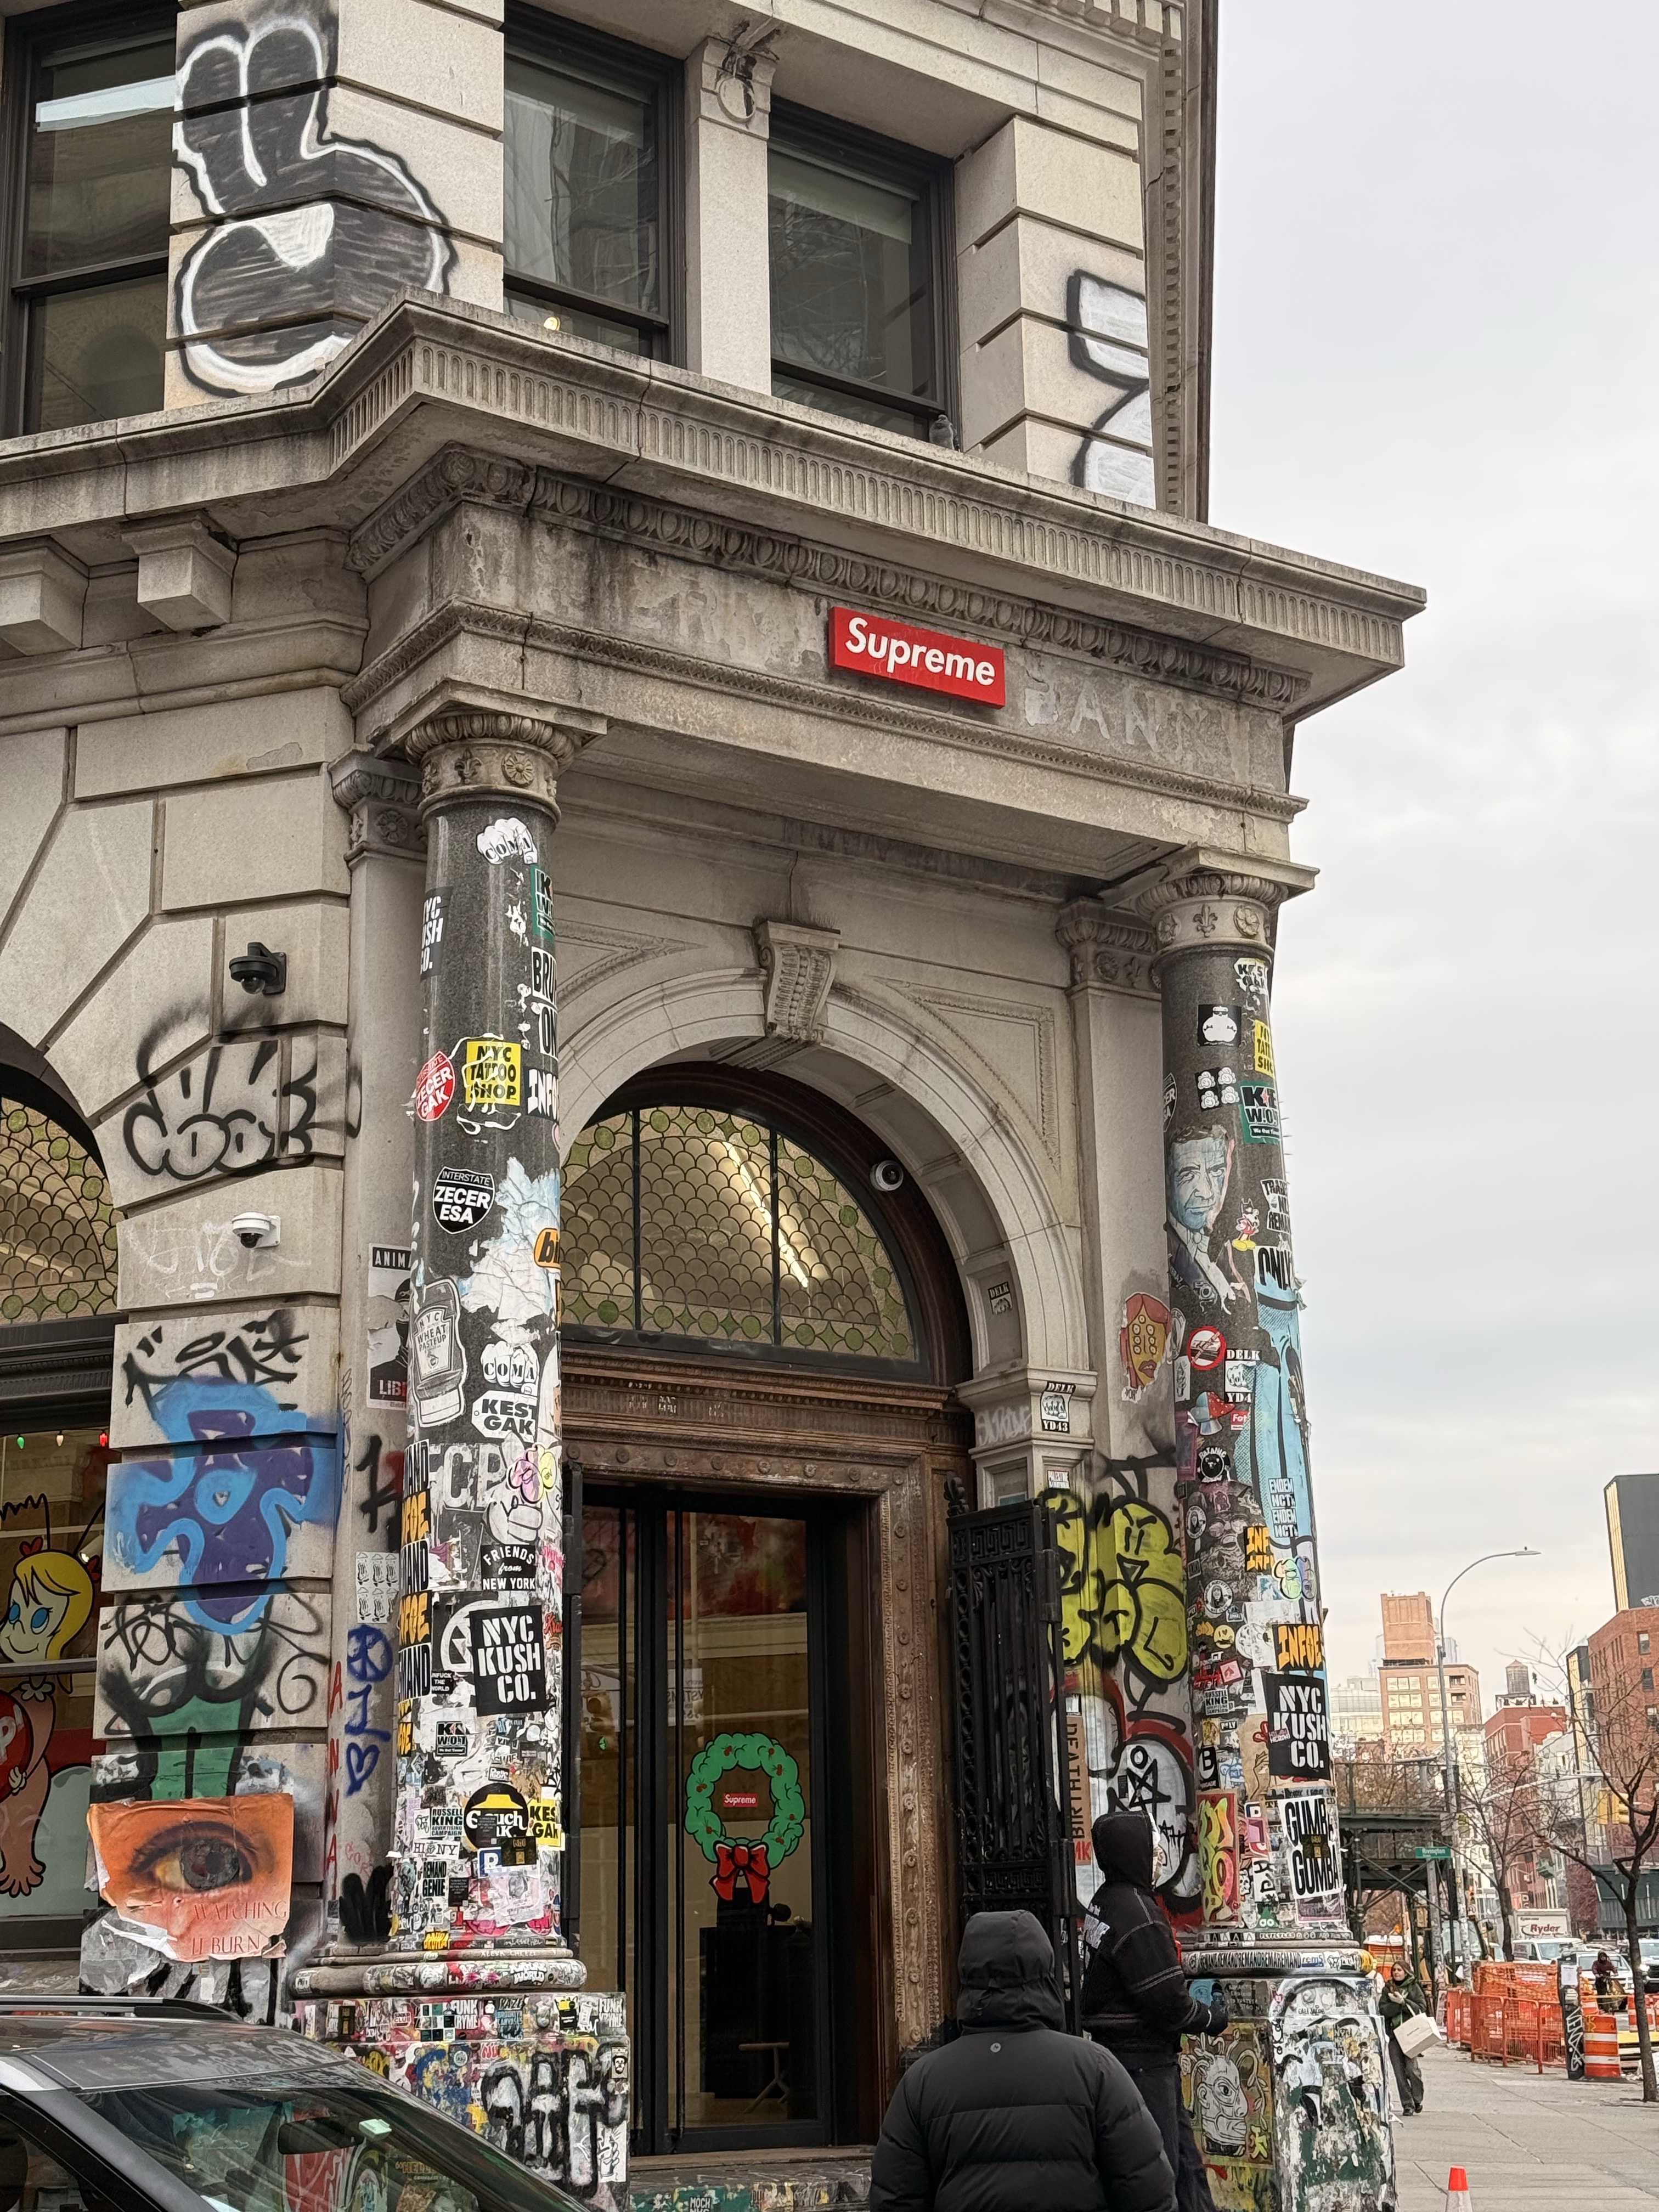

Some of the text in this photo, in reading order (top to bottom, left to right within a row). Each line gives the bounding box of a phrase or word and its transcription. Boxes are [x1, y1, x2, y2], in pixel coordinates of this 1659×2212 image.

[845, 617, 995, 685] Supreme
[477, 1046, 511, 1062] NYC
[470, 1064, 516, 1082] TATTOO
[470, 1085, 517, 1099] SHOP
[528, 1069, 558, 1124] INFO
[421, 1086, 449, 1118] GAK
[442, 1170, 490, 1186] INTERSTATE
[434, 1186, 490, 1209] ZECER
[439, 1204, 473, 1224] ESA
[990, 1283, 1010, 1299] DELK
[417, 1324, 447, 1344] WHEAT
[1227, 1350, 1260, 1360] DELK
[484, 1363, 535, 1380] COMA
[1047, 1382, 1075, 1393] DELK
[1227, 1392, 1252, 1403] YD4
[482, 1398, 537, 1420] KEST
[483, 1414, 533, 1436] GAK
[1043, 1420, 1069, 1432] YD43
[483, 1545, 534, 1565] FRIENDS
[498, 1563, 522, 1575] from
[483, 1578, 535, 1590] NEW YORK
[482, 1615, 534, 1646] NYC
[477, 1643, 541, 1677] KUSH
[496, 1673, 537, 1703] CO.
[1206, 1697, 1228, 1706] KING
[1279, 1685, 1322, 1713] NYC
[1273, 1712, 1327, 1741] KUSH
[1290, 1741, 1324, 1768] CO.
[724, 1793, 757, 1806] Supreme
[432, 1816, 462, 1825] KING
[466, 1810, 527, 1830] Cuch
[530, 1805, 556, 1821] KES
[436, 1844, 458, 1855] NY
[422, 1878, 445, 1897] GENIE
[194, 1900, 287, 1920] WATCHING
[1530, 1923, 1560, 1934] Ryder
[212, 1934, 260, 1954] BURN
